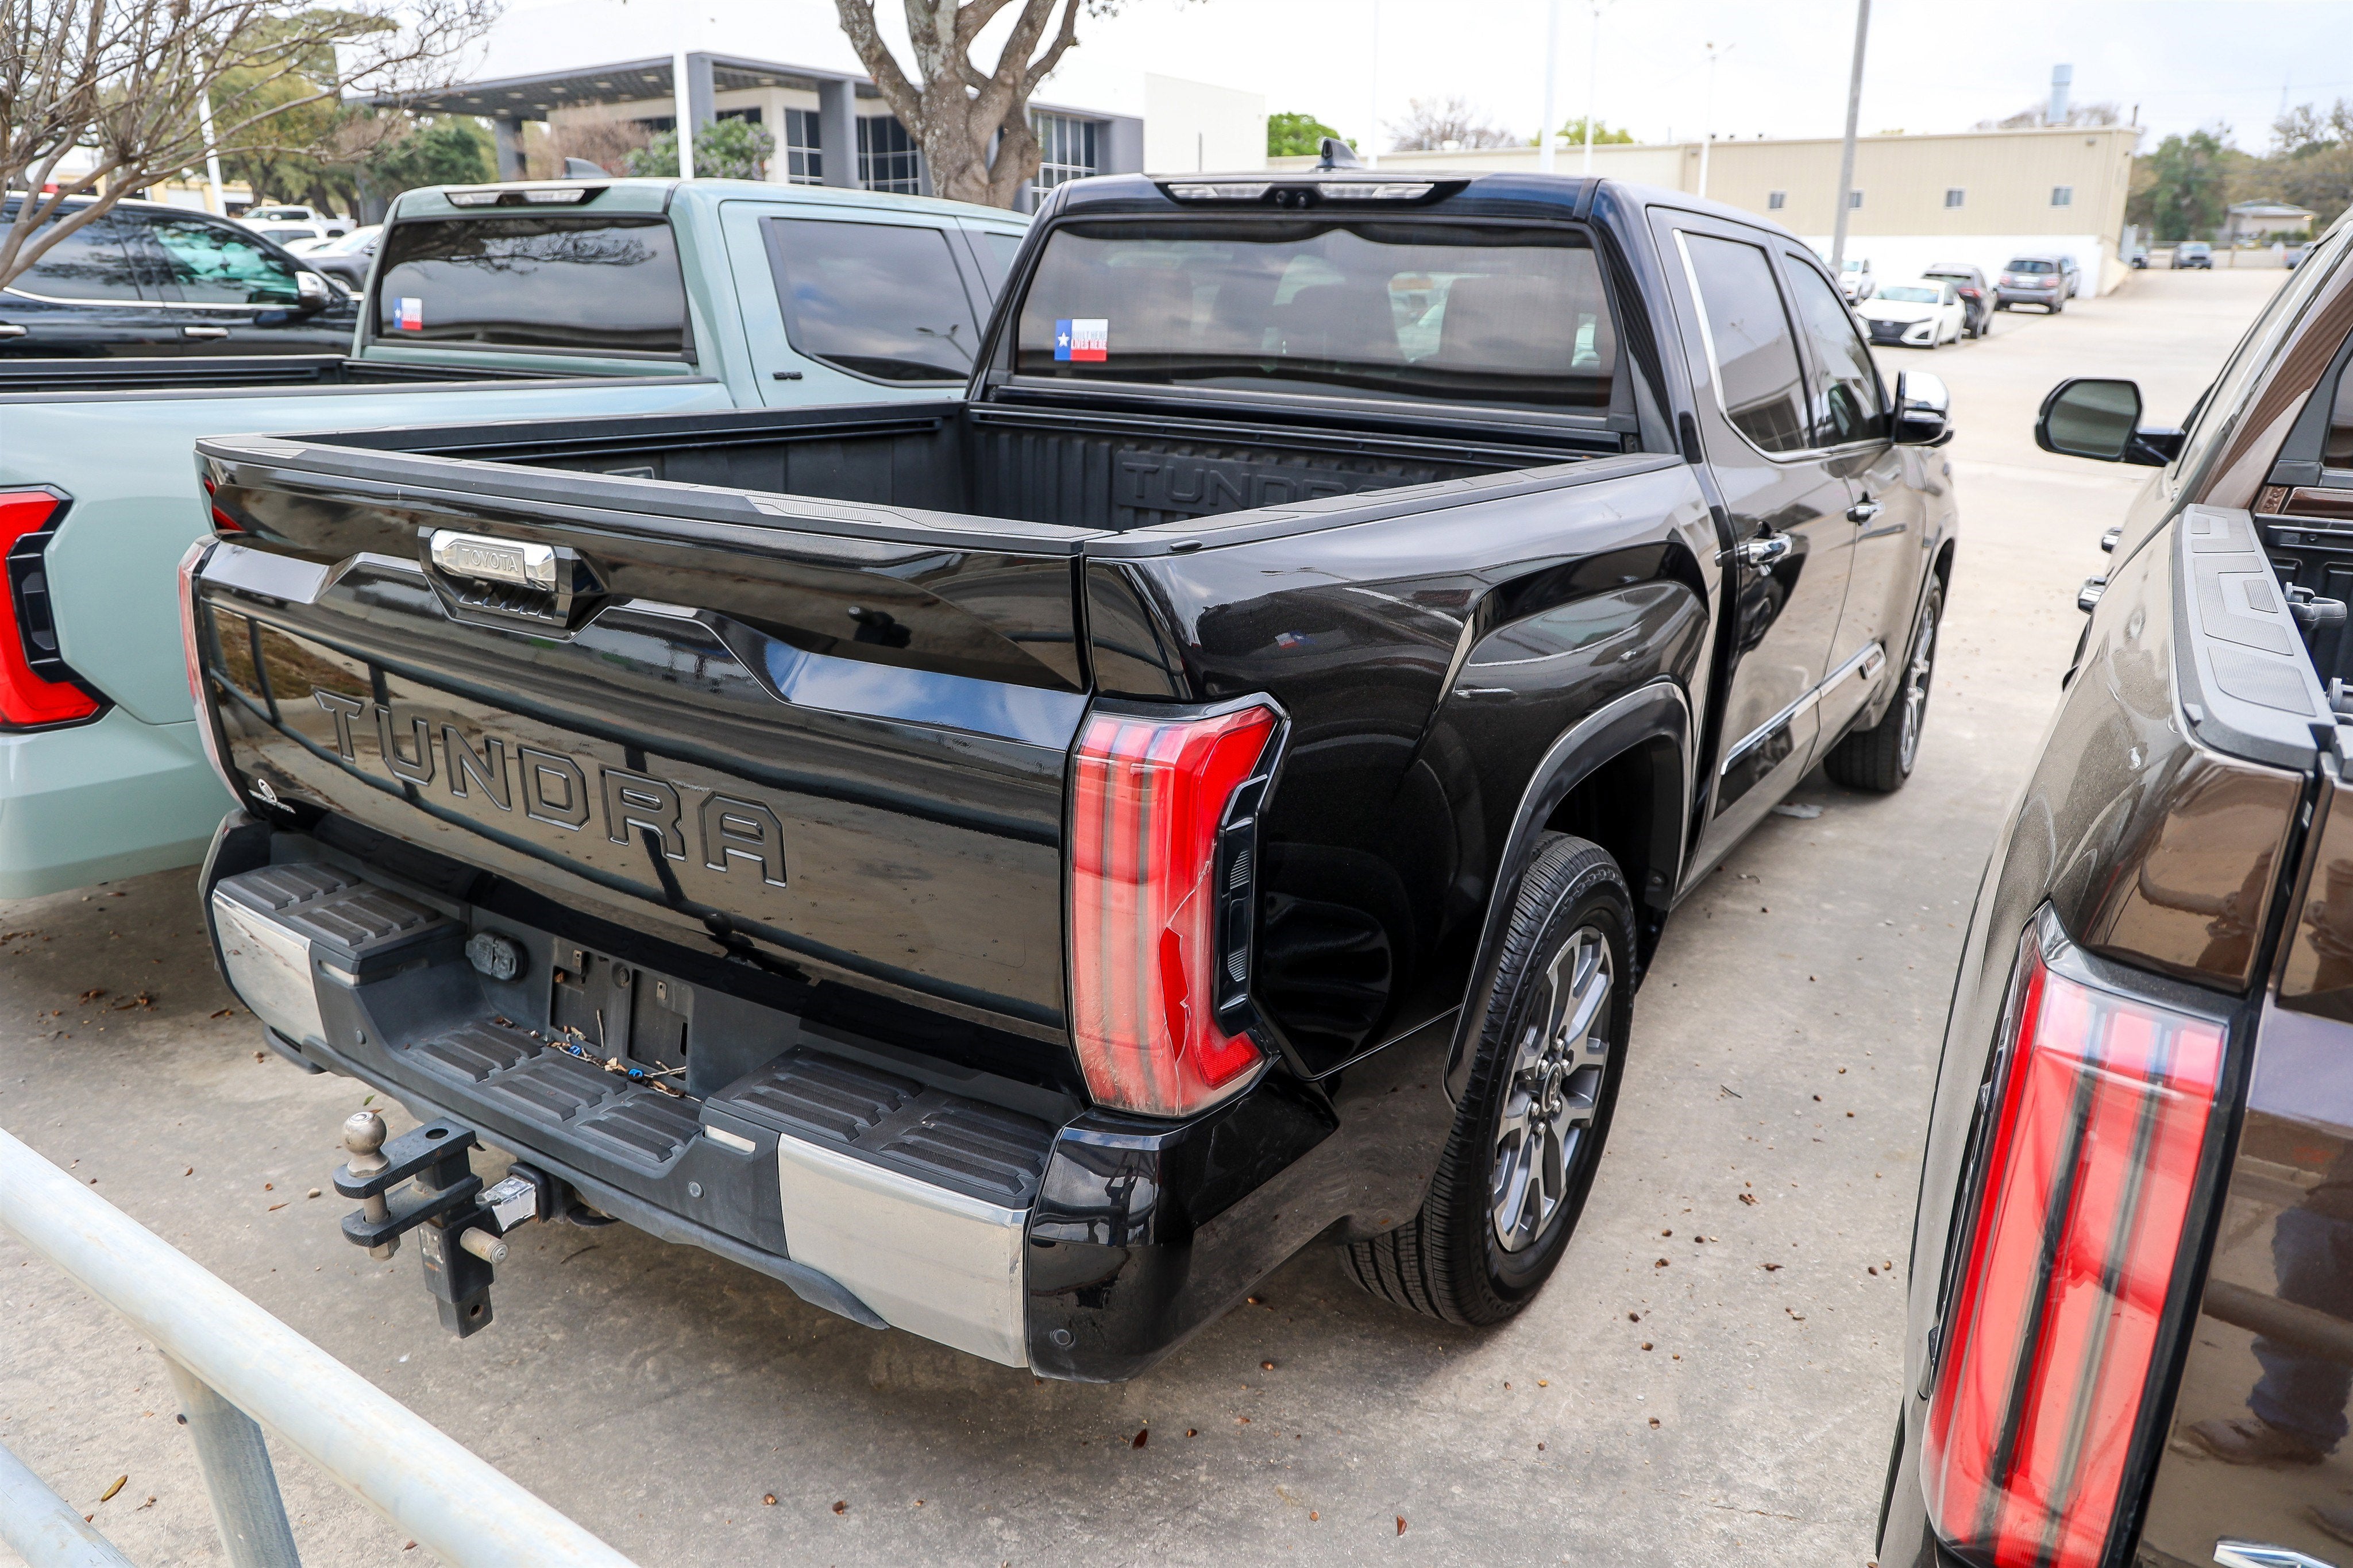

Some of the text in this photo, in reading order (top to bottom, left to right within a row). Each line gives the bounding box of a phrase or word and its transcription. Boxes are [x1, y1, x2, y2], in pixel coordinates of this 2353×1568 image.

[1122, 462, 1388, 508] TUND
[461, 547, 519, 572] TOYOTA
[311, 686, 788, 888] TUNDRA
